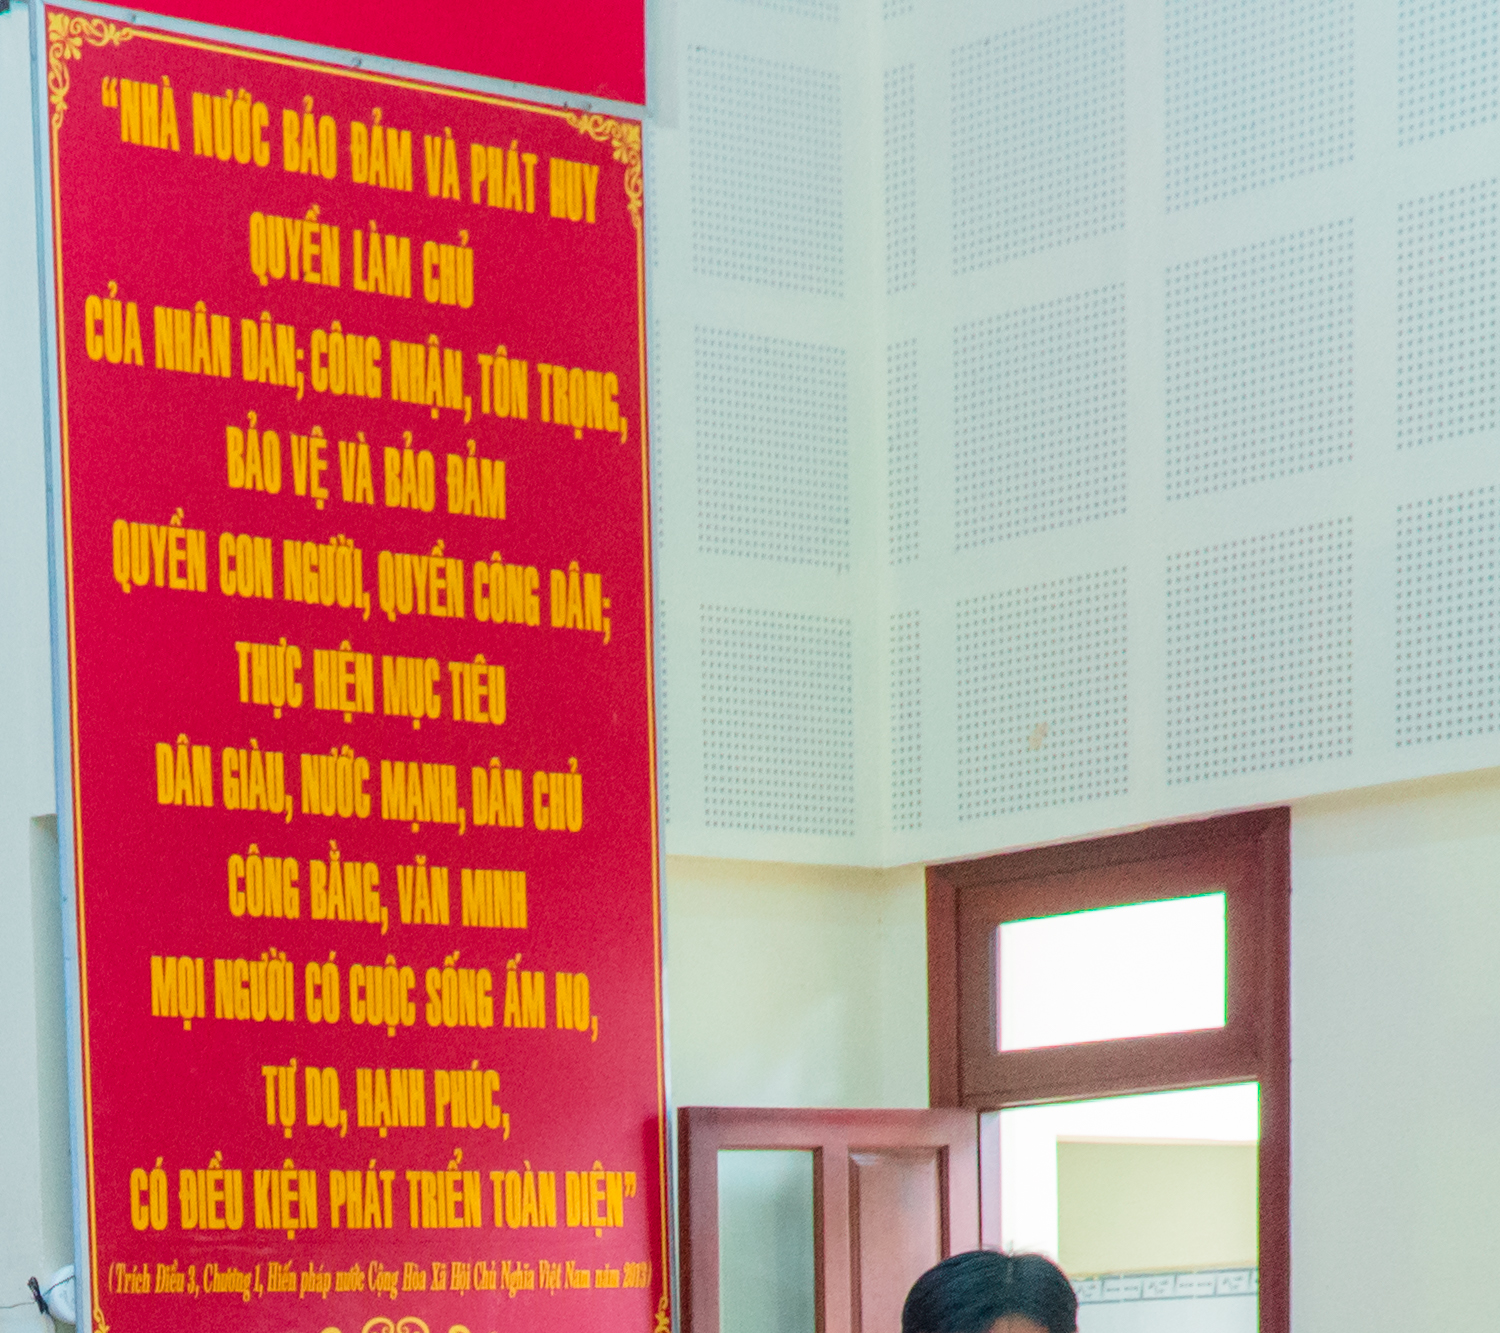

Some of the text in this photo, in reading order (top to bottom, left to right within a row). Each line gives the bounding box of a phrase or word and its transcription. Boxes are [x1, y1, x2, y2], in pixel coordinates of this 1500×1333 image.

[192, 88, 270, 167] NƯỚC
[283, 95, 337, 179] BẢO
[350, 108, 412, 191] ĐẢM
[424, 127, 460, 199] VÀ
[471, 140, 537, 212] PHÁT
[550, 158, 599, 223] HUY
[250, 205, 473, 308] QUYỀN LÀM CHỦ
[85, 281, 627, 443] CỦA NHÂN DÂN; CÔNG NHẬN, TÔN TRỌNG,
[226, 411, 505, 519] BẢO VỆ VÀ BẢO ĐẢM
[113, 508, 610, 643] QUYỀN CON NGƯỜI, QUYỀN CÔNG DÂN;
[236, 637, 506, 729] THỰC HIỆN MỤC TIÊU
[156, 734, 582, 834] DÂN GIÀU, NƯỚC MẠNH, DÂN CHỦ
[228, 840, 527, 934] CÔNG BẰNG, VĂN MINH
[151, 948, 598, 1042] MỌI NGƯỜI CÓ CUỘC SỐNG ẤM NO,
[262, 1058, 510, 1140] TỰ DO, HẠNH PHÚC,
[131, 1157, 167, 1230] CÓ
[179, 1151, 243, 1229] ĐIỀU
[254, 1159, 317, 1239] KIỆN
[330, 1159, 395, 1228] PHÁT
[406, 1148, 482, 1228] TRIỂN
[490, 1160, 558, 1229] TOÀN
